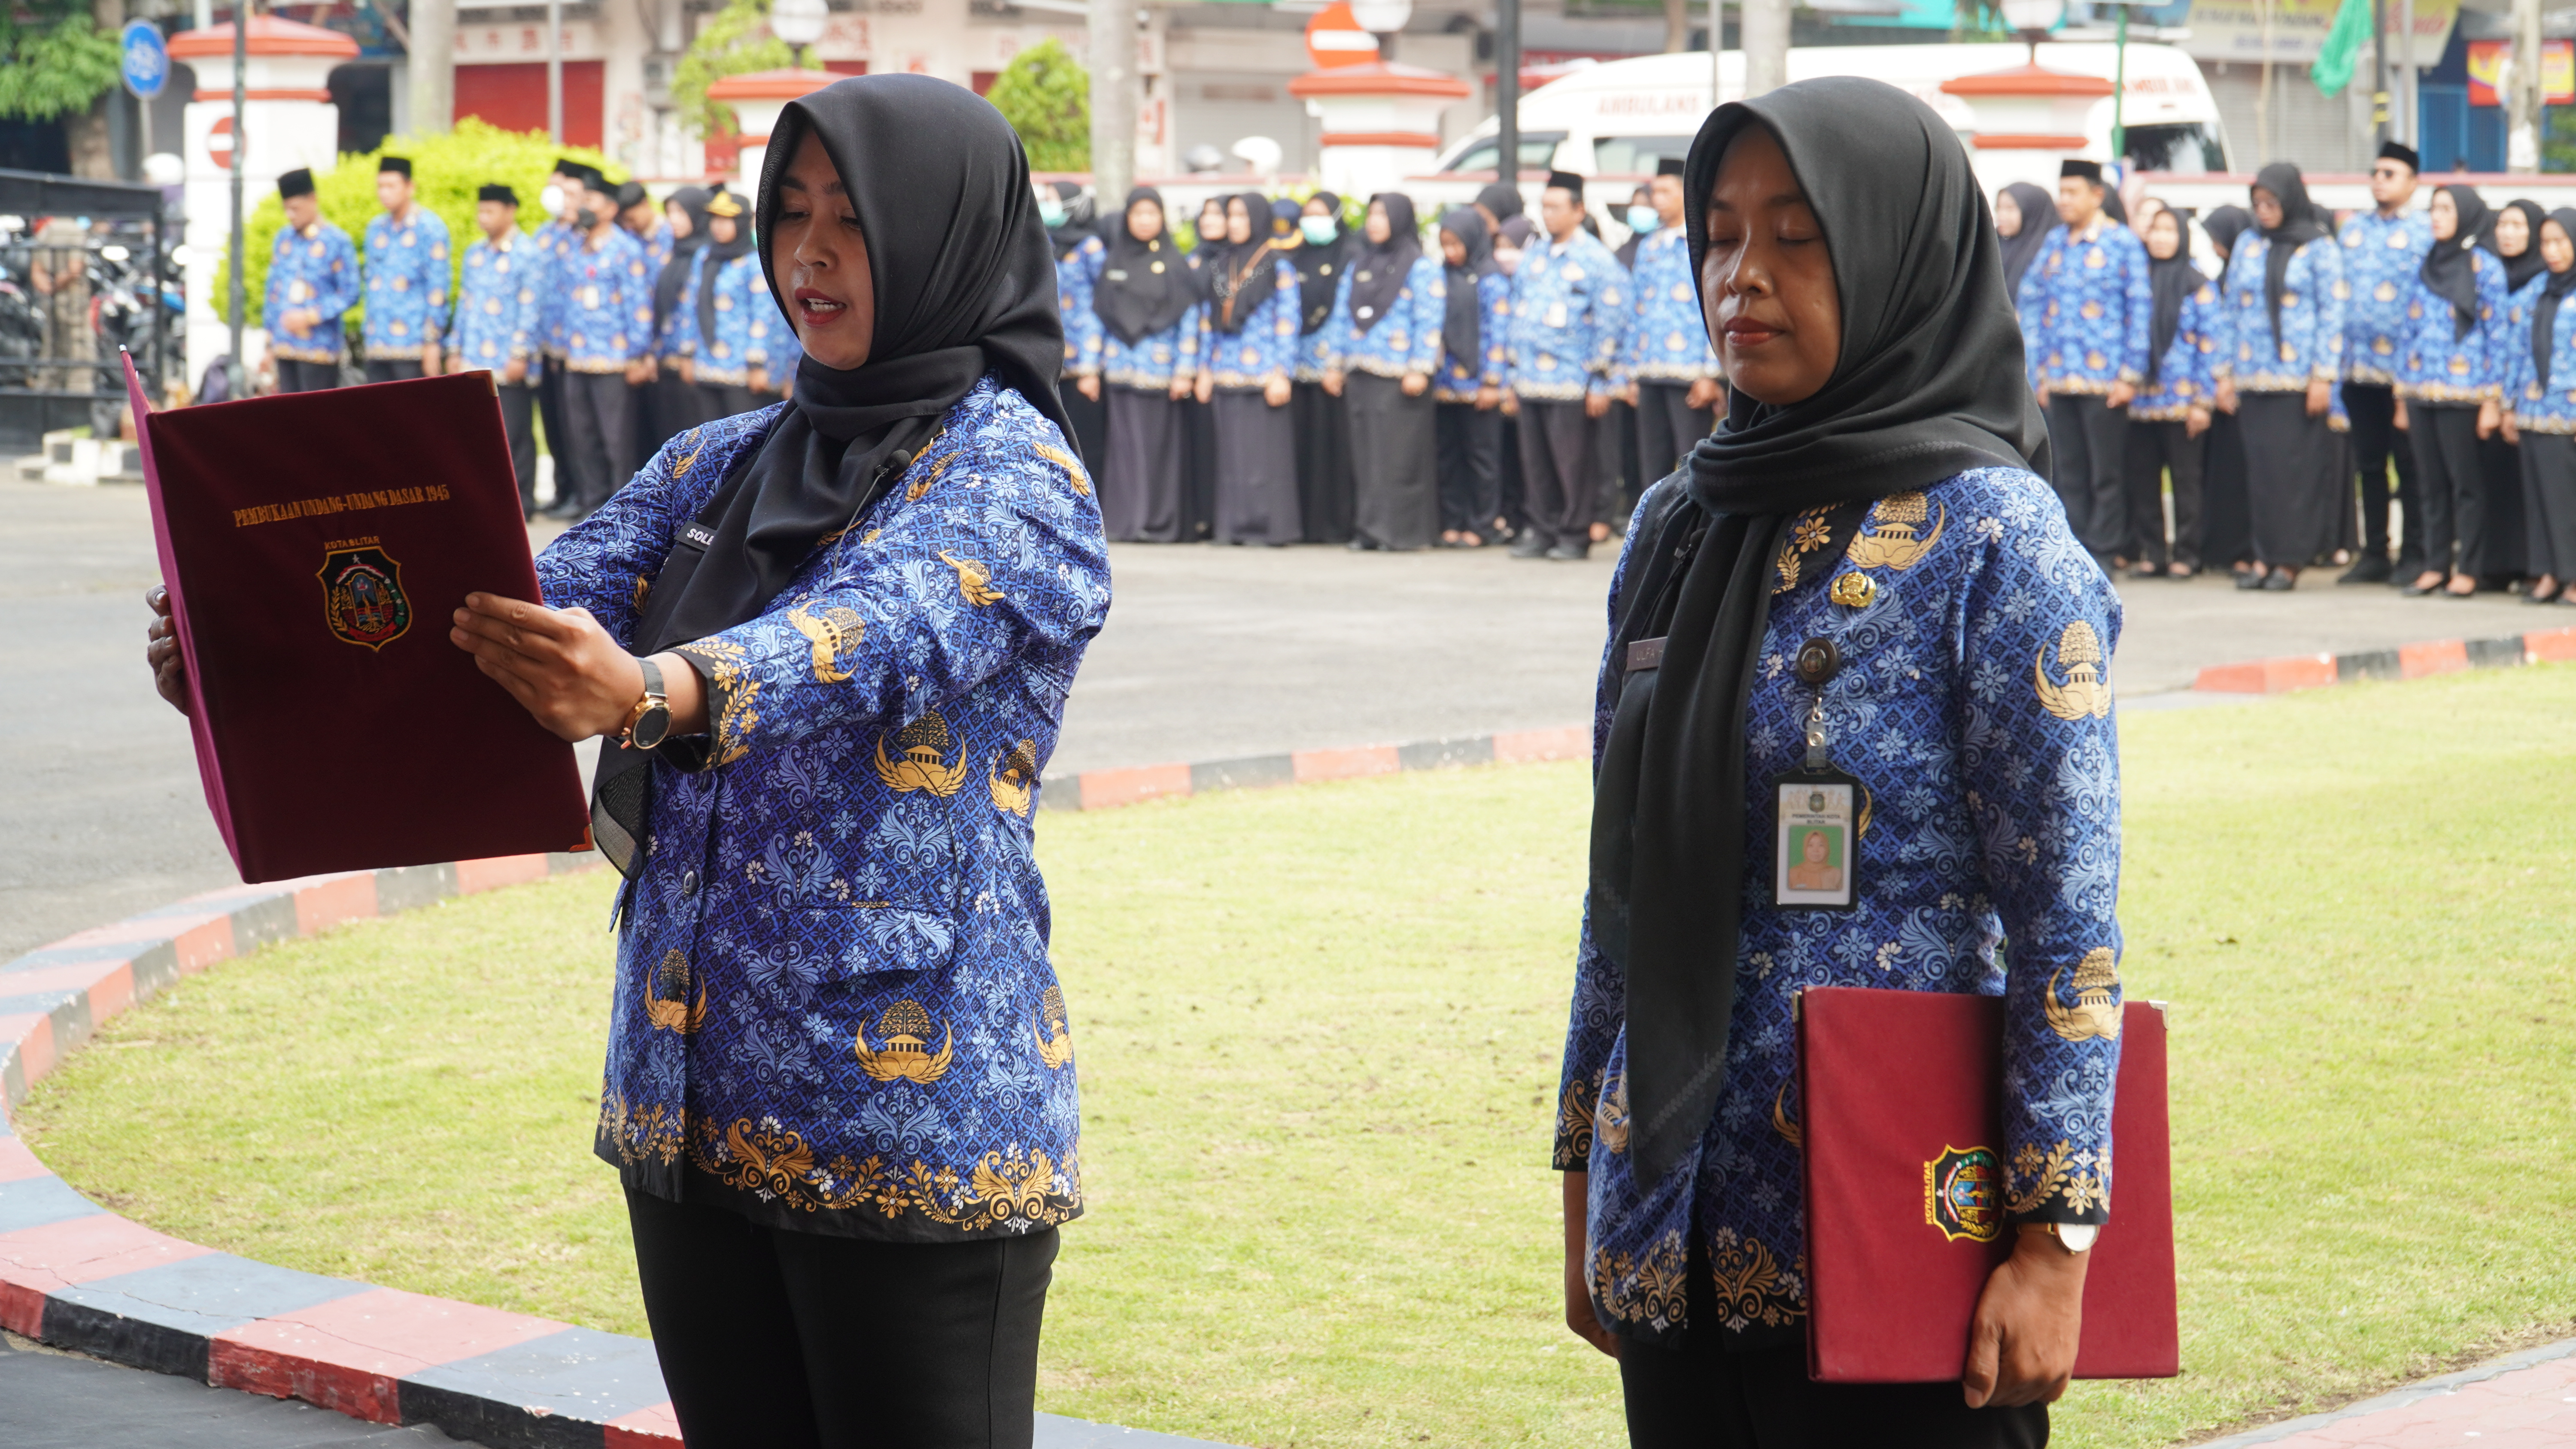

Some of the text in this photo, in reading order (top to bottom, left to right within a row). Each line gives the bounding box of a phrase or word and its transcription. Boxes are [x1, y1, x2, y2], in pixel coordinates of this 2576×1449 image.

[232, 484, 450, 527] PEMBUKAAN UNDANG-UNDANG DASAR 1945
[324, 536, 380, 550] KOTA BLITAR
[1923, 1161, 1932, 1225] KOTA BLITAR
